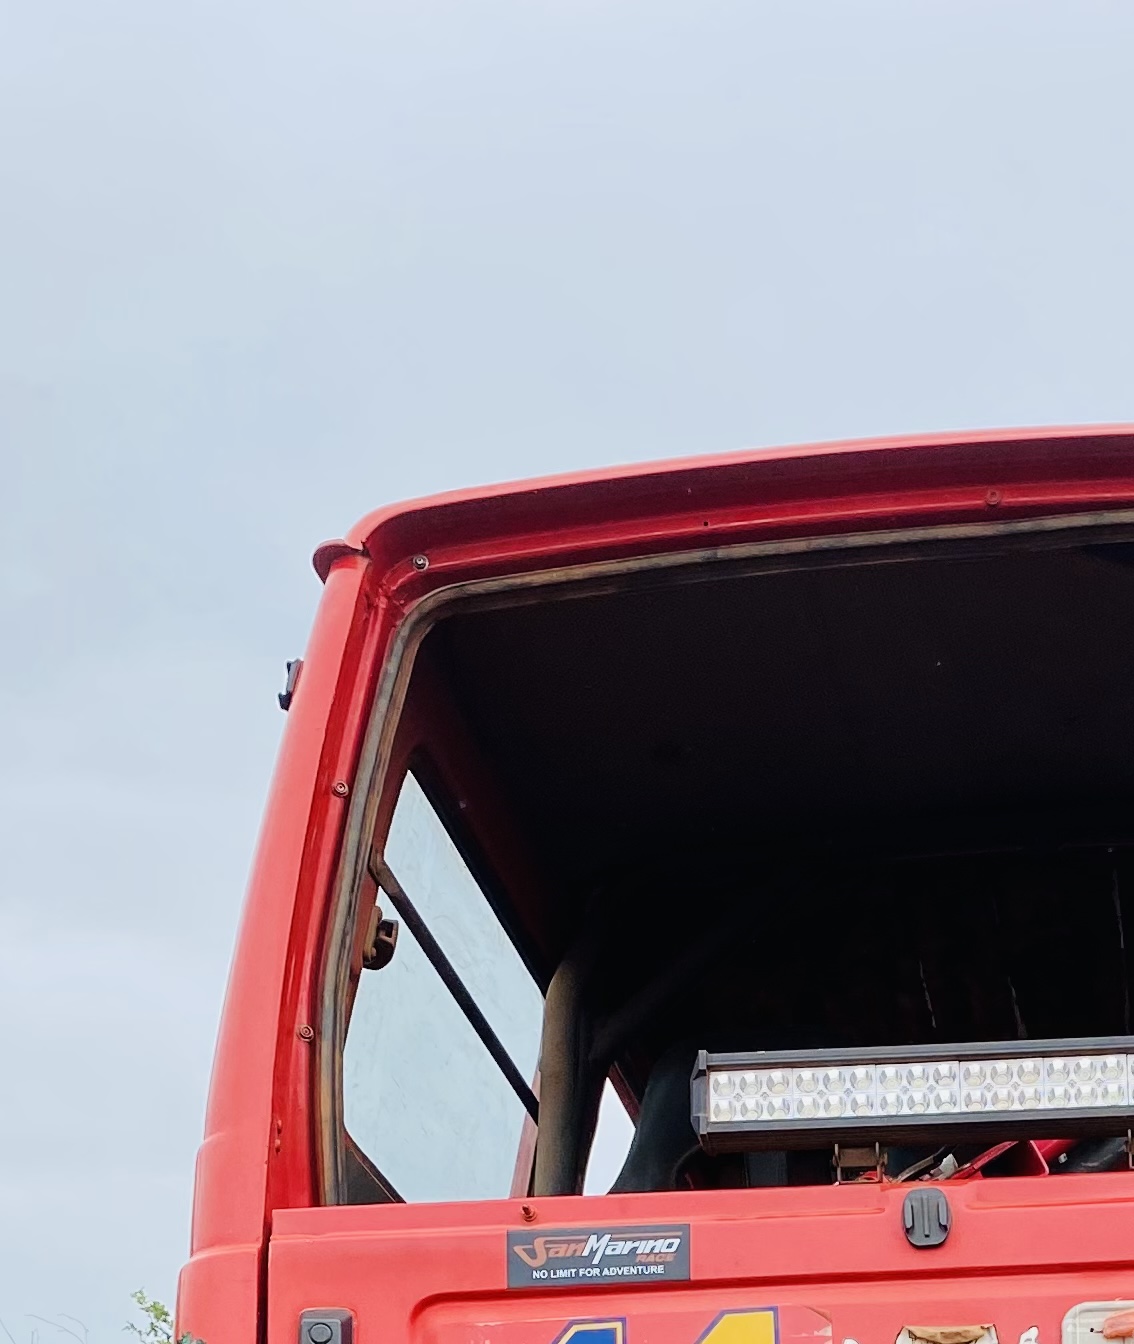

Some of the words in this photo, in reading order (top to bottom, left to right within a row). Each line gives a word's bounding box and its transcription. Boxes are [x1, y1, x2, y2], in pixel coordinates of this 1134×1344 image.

[636, 1253, 676, 1263] RACE
[532, 1269, 548, 1279] NO
[550, 1268, 577, 1279] LIMIT
[579, 1267, 600, 1277] FOR
[602, 1265, 665, 1276] ADVENTURE
